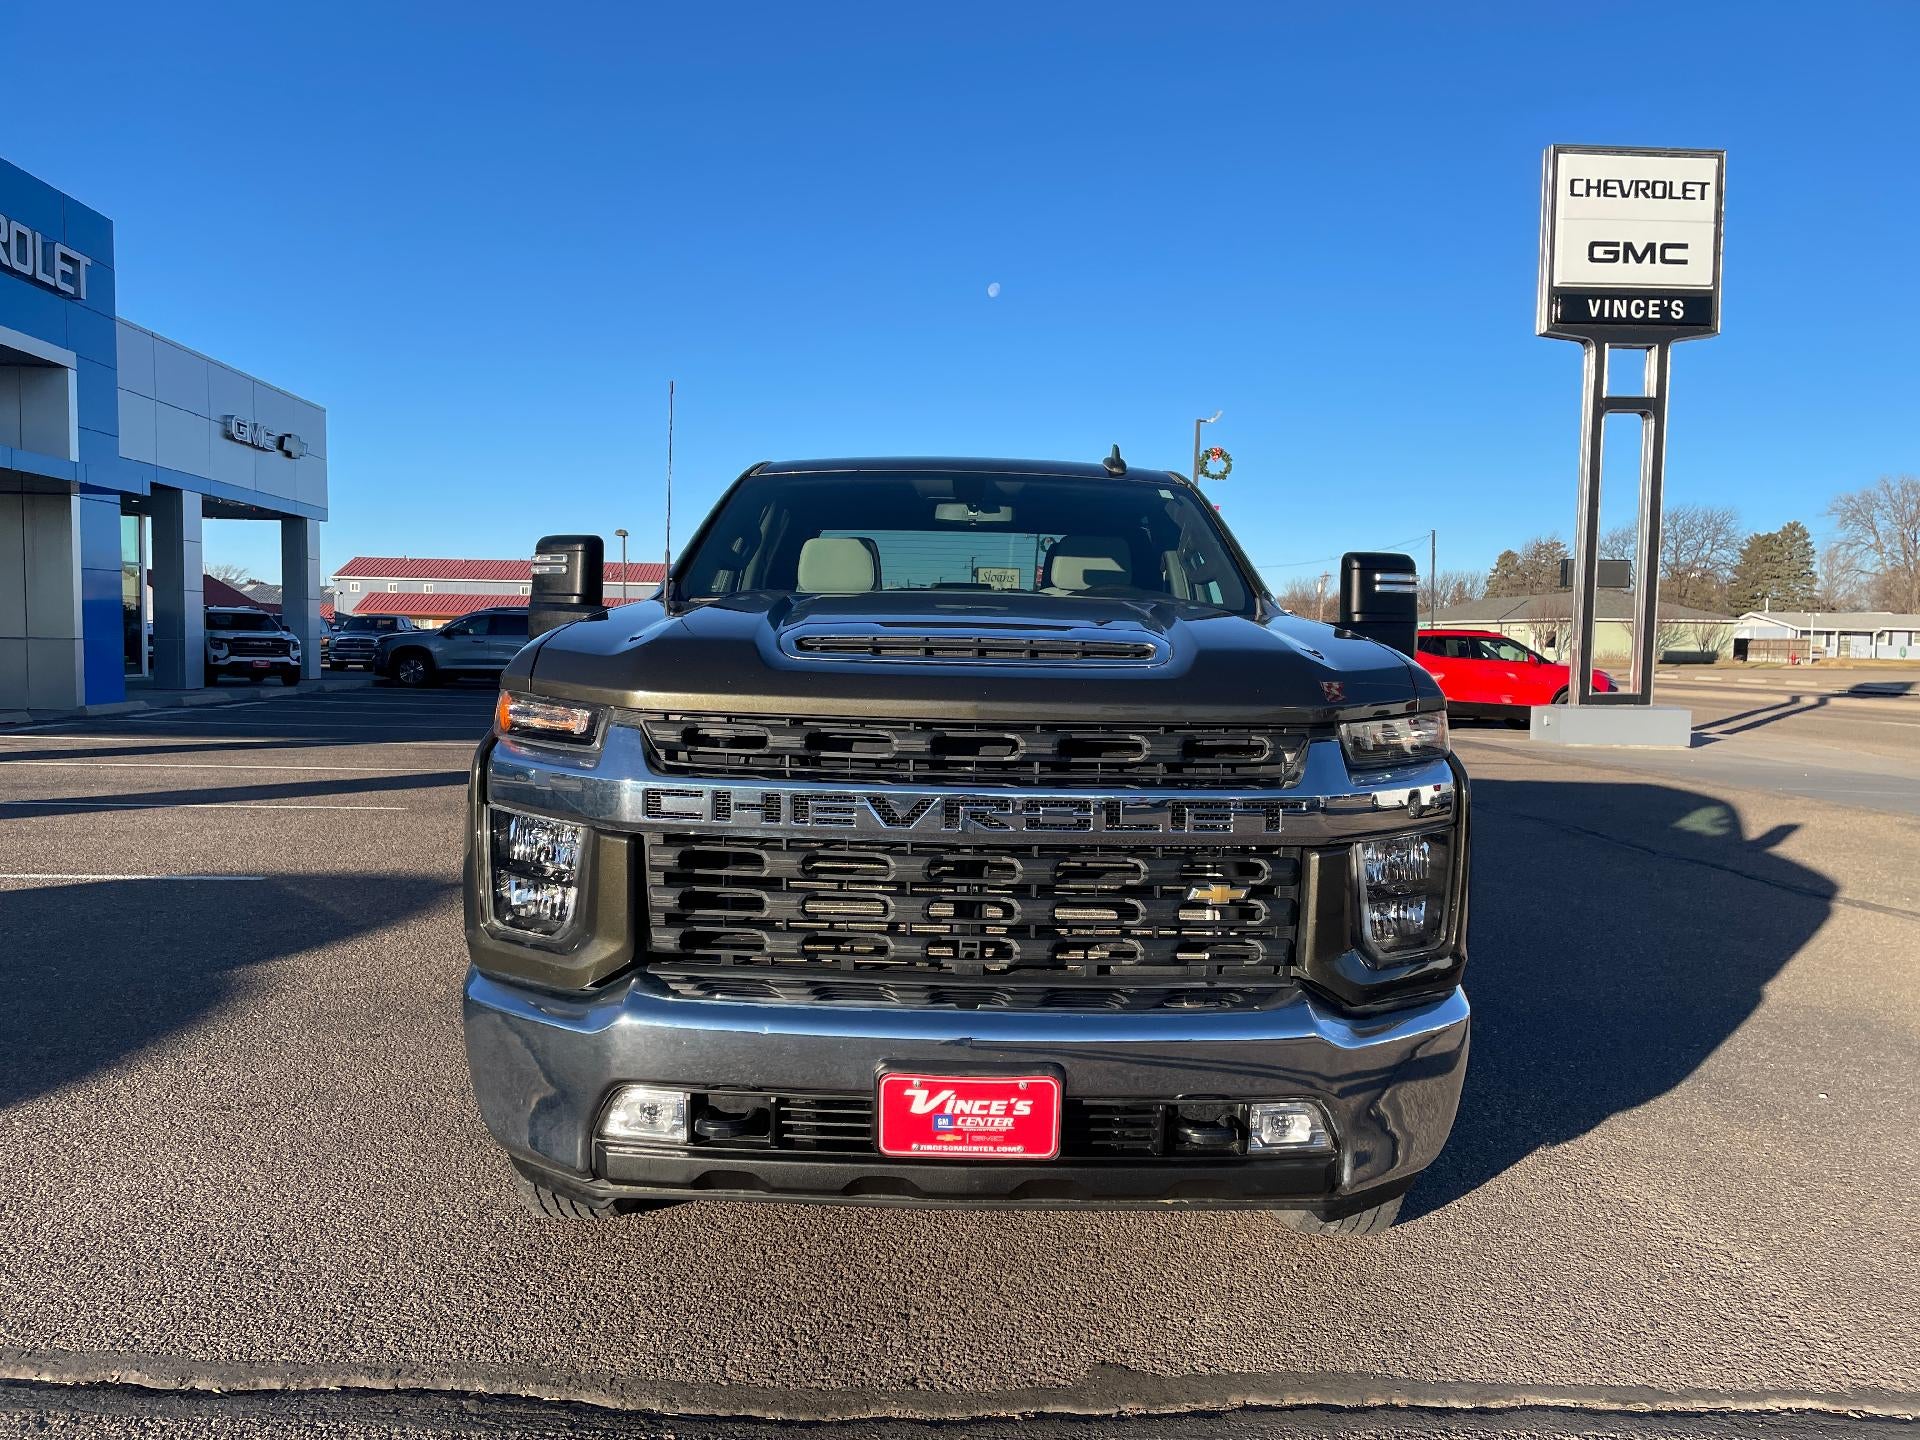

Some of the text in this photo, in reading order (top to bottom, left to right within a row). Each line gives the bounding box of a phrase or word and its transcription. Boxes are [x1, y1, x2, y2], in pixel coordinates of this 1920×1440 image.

[1569, 178, 1711, 201] CHEVROLET
[1587, 240, 1689, 265] GMC
[1588, 299, 1685, 319] VINCE'S
[231, 415, 276, 452] GMC
[642, 788, 1306, 833] CHEVROLET
[904, 1089, 1033, 1116] VINCE'S
[957, 1116, 1015, 1127] CENTER
